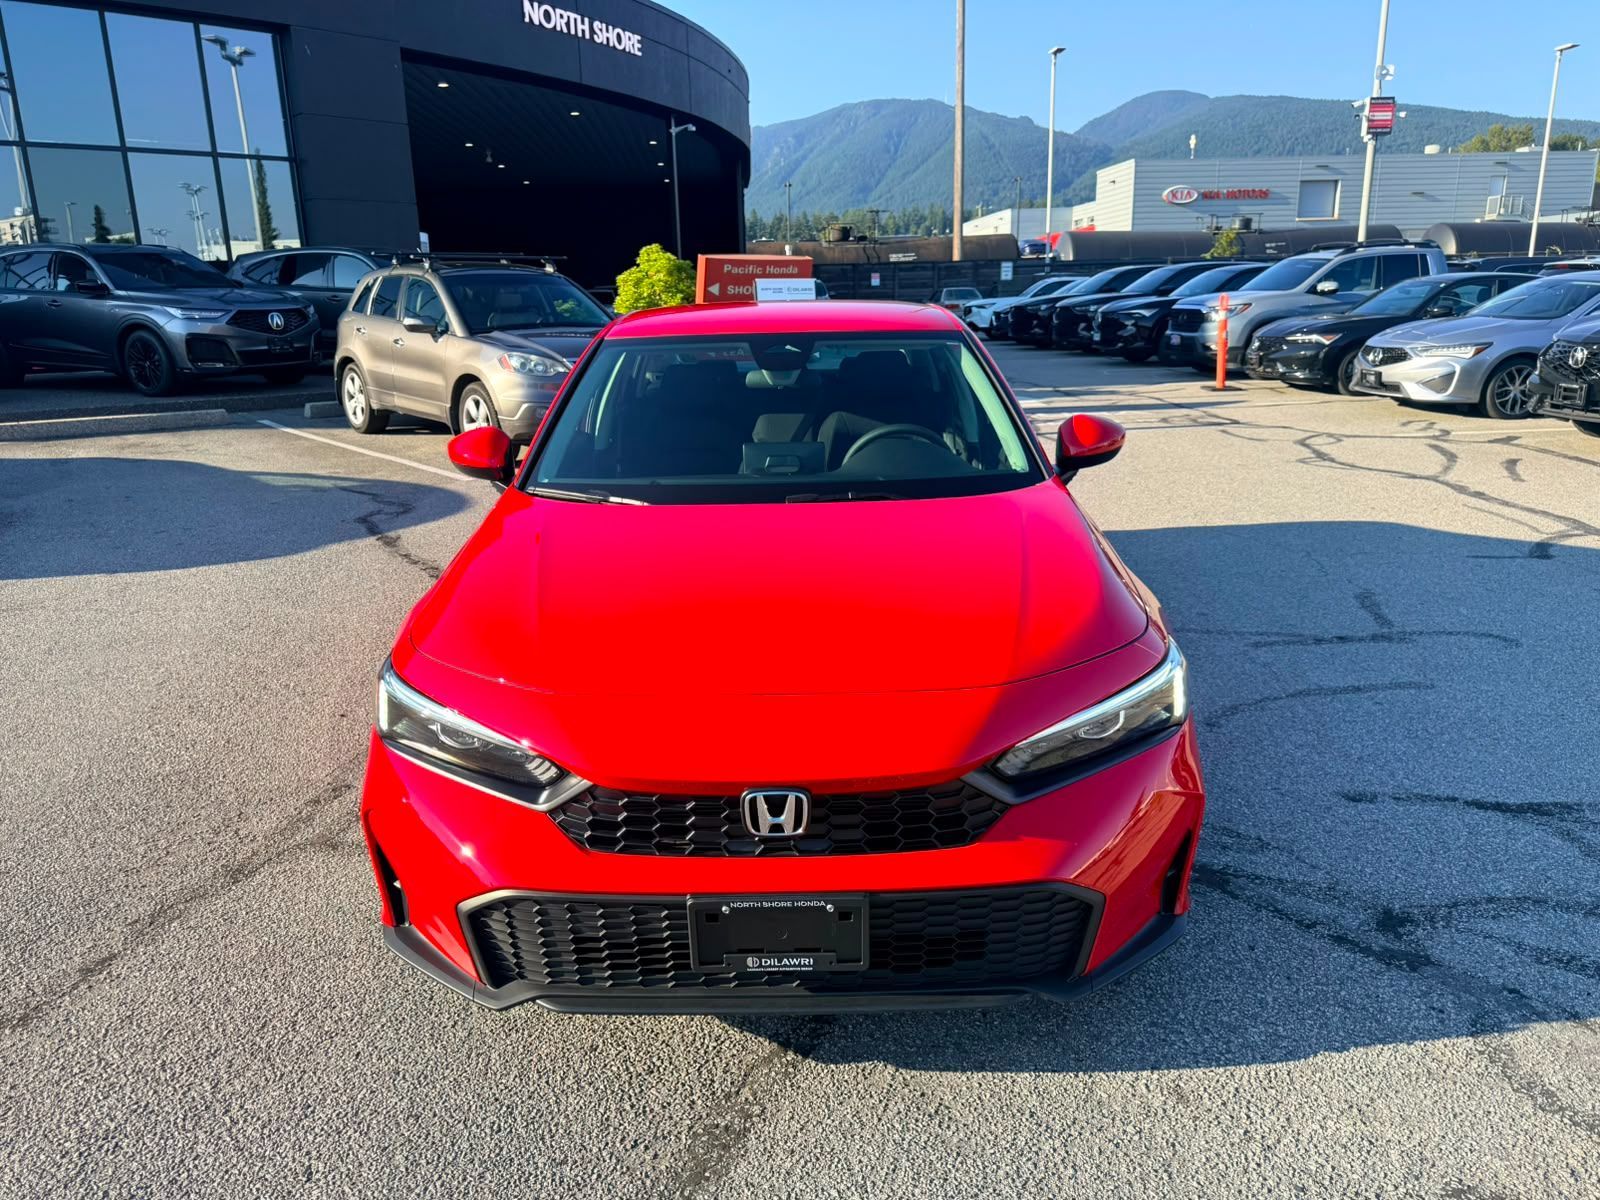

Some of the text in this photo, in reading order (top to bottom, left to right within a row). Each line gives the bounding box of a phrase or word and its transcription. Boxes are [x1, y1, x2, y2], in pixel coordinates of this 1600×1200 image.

[522, 0, 642, 56] NORTH SHORE
[724, 264, 798, 274] Pacific Honda
[727, 285, 754, 295] SHO
[730, 900, 826, 909] NORTH SHORE HONDA
[761, 957, 814, 966] DILAWRI
